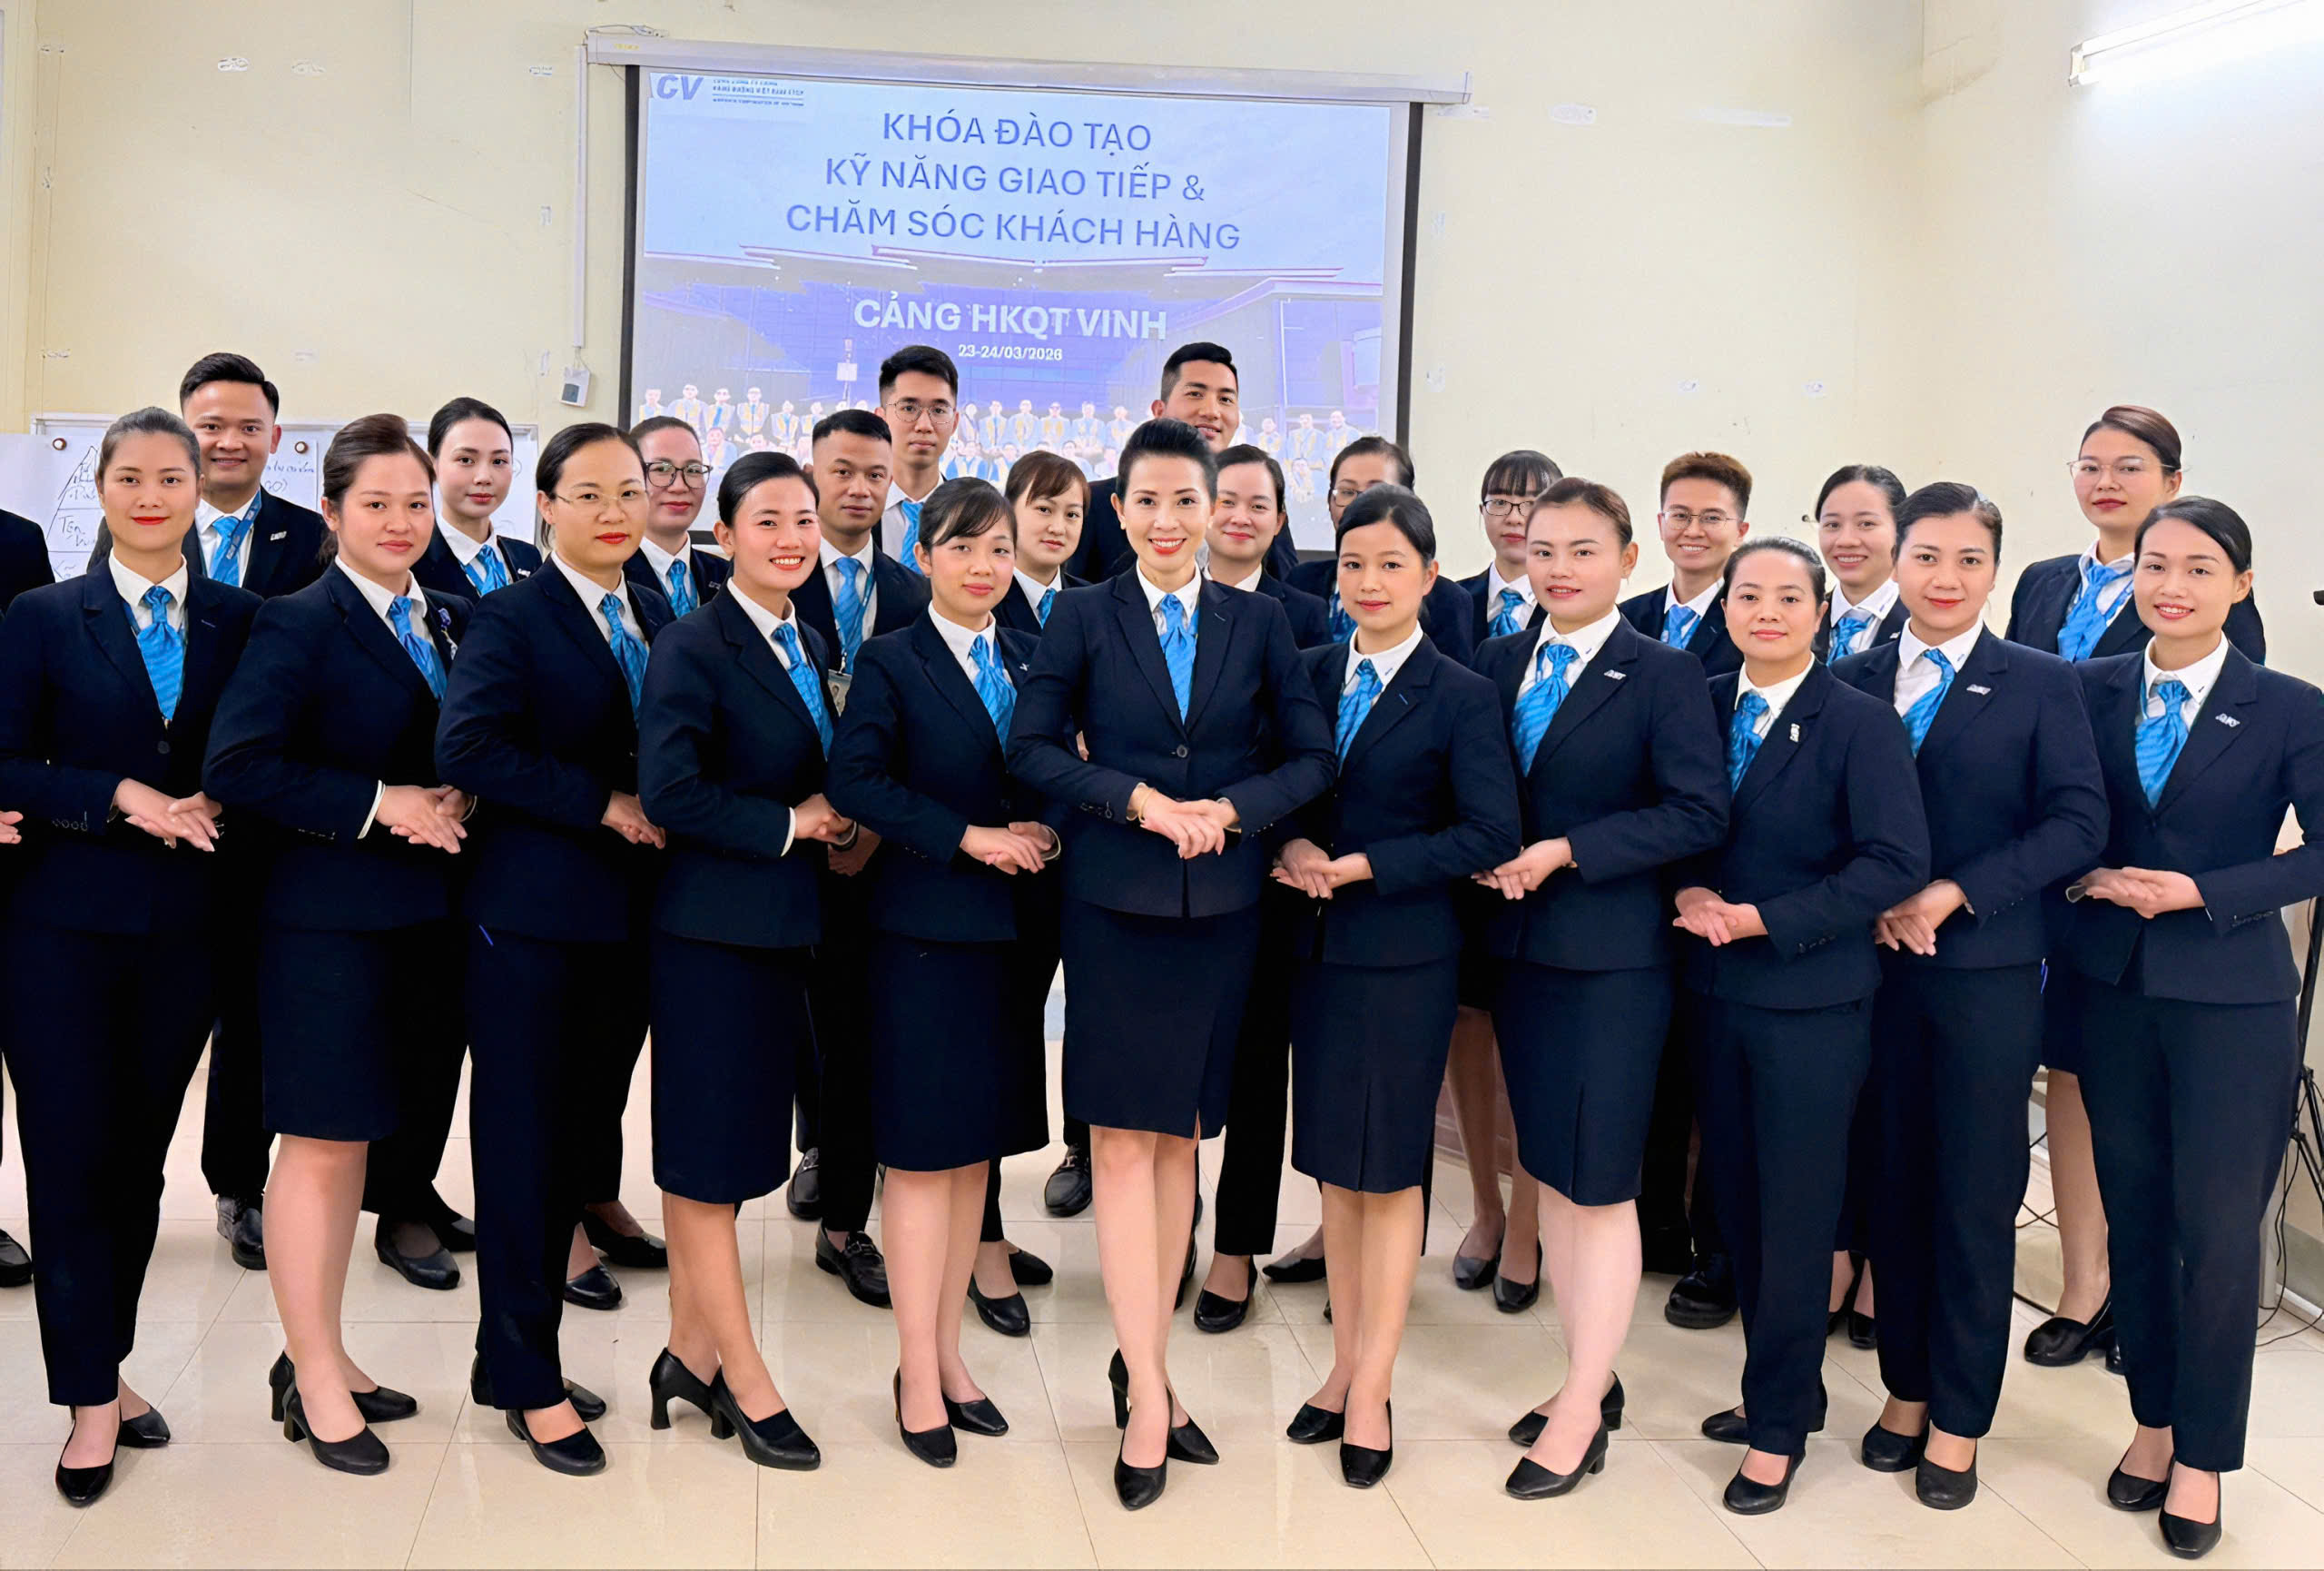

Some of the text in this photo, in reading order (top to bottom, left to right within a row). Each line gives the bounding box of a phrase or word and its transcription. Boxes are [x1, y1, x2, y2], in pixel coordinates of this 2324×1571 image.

[883, 108, 1151, 156] KHÓA ĐÀO TẠO
[826, 153, 1206, 202] KỸ NĂNG GIAO TIẾP &
[786, 200, 1241, 250] CHĂM SÓC KHÁCH HÀNG
[853, 290, 1167, 341] CẢNG HKQT VINH
[958, 343, 1063, 361] 23-24/03/2026
